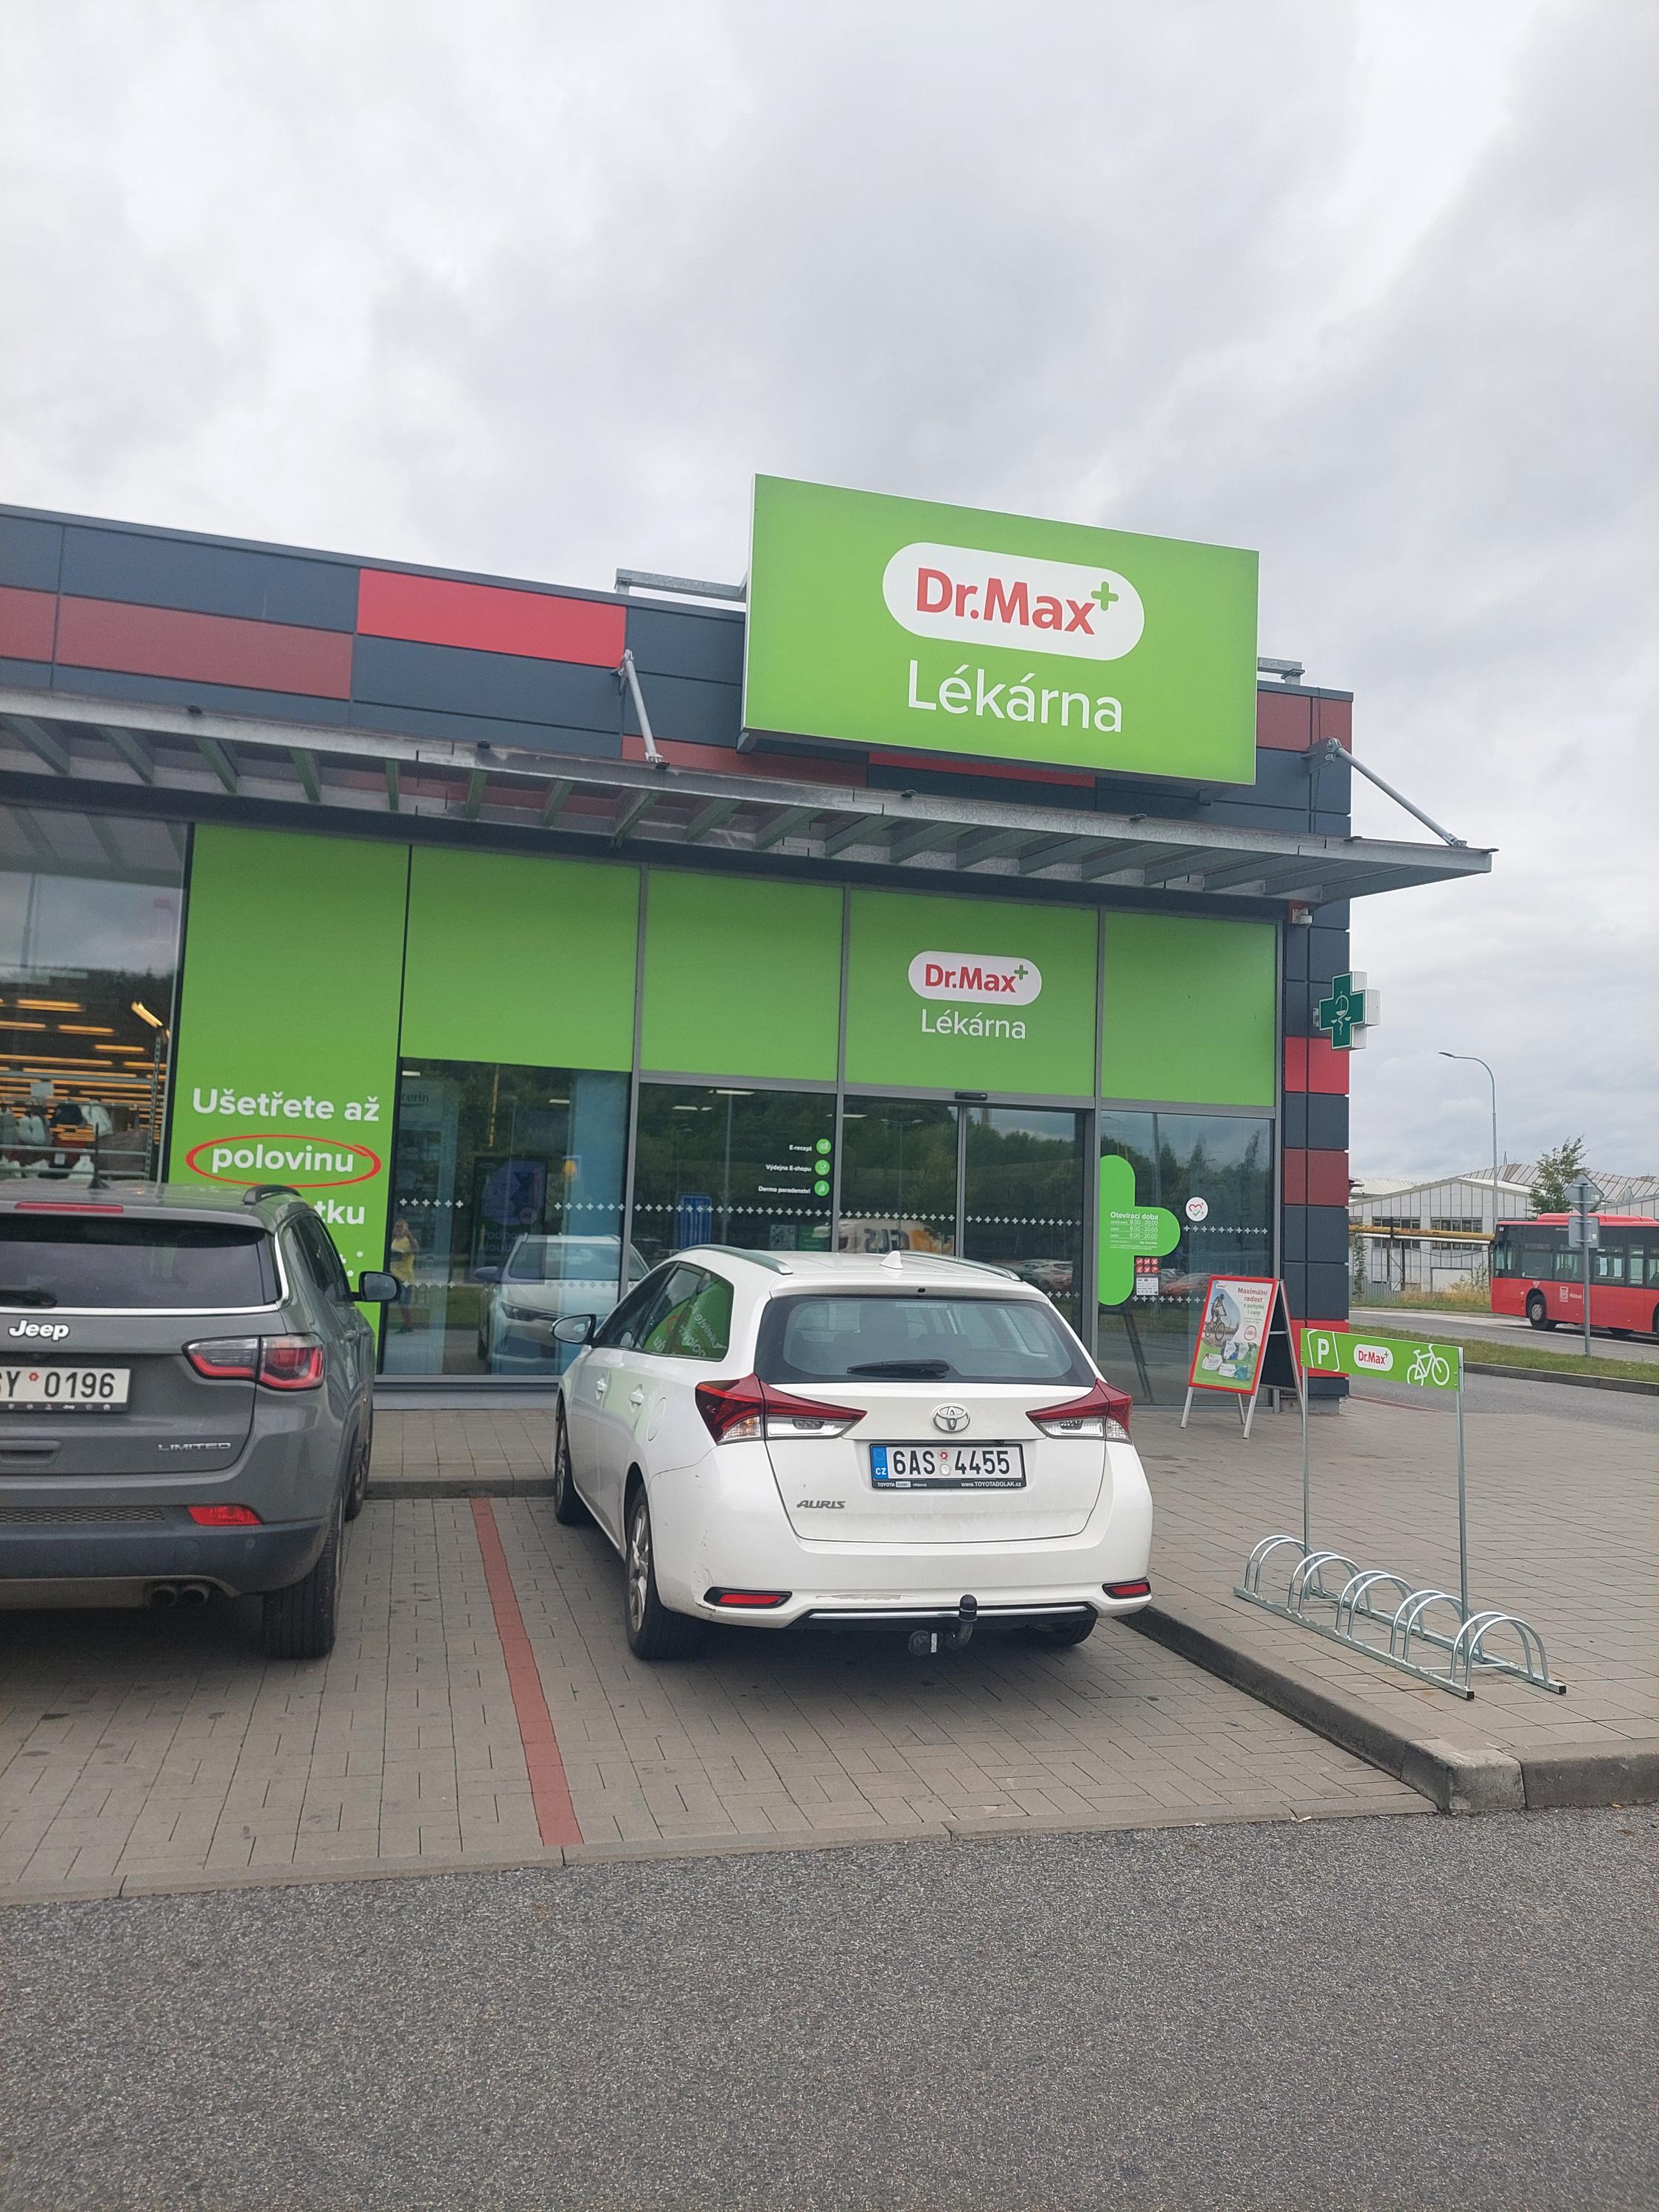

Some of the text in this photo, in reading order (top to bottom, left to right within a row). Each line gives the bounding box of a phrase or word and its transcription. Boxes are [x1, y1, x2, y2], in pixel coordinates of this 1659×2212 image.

[908, 659, 1122, 732] Lékárna
[922, 1008, 1026, 1040] Lékárna
[192, 1087, 380, 1121] Ušetřete až
[212, 1144, 354, 1174] polovinu
[313, 1198, 366, 1225] tku
[1110, 1211, 1141, 1220] Otevírací
[1237, 1287, 1268, 1295] Maximální
[9, 1320, 69, 1340] Jeep
[1318, 1338, 1330, 1364] P
[44, 1371, 115, 1399] 0196
[158, 1442, 232, 1452] LIMITED
[875, 1467, 887, 1475] CZ
[893, 1450, 1010, 1475] 6AS 4455
[796, 1500, 846, 1509] AURIS
